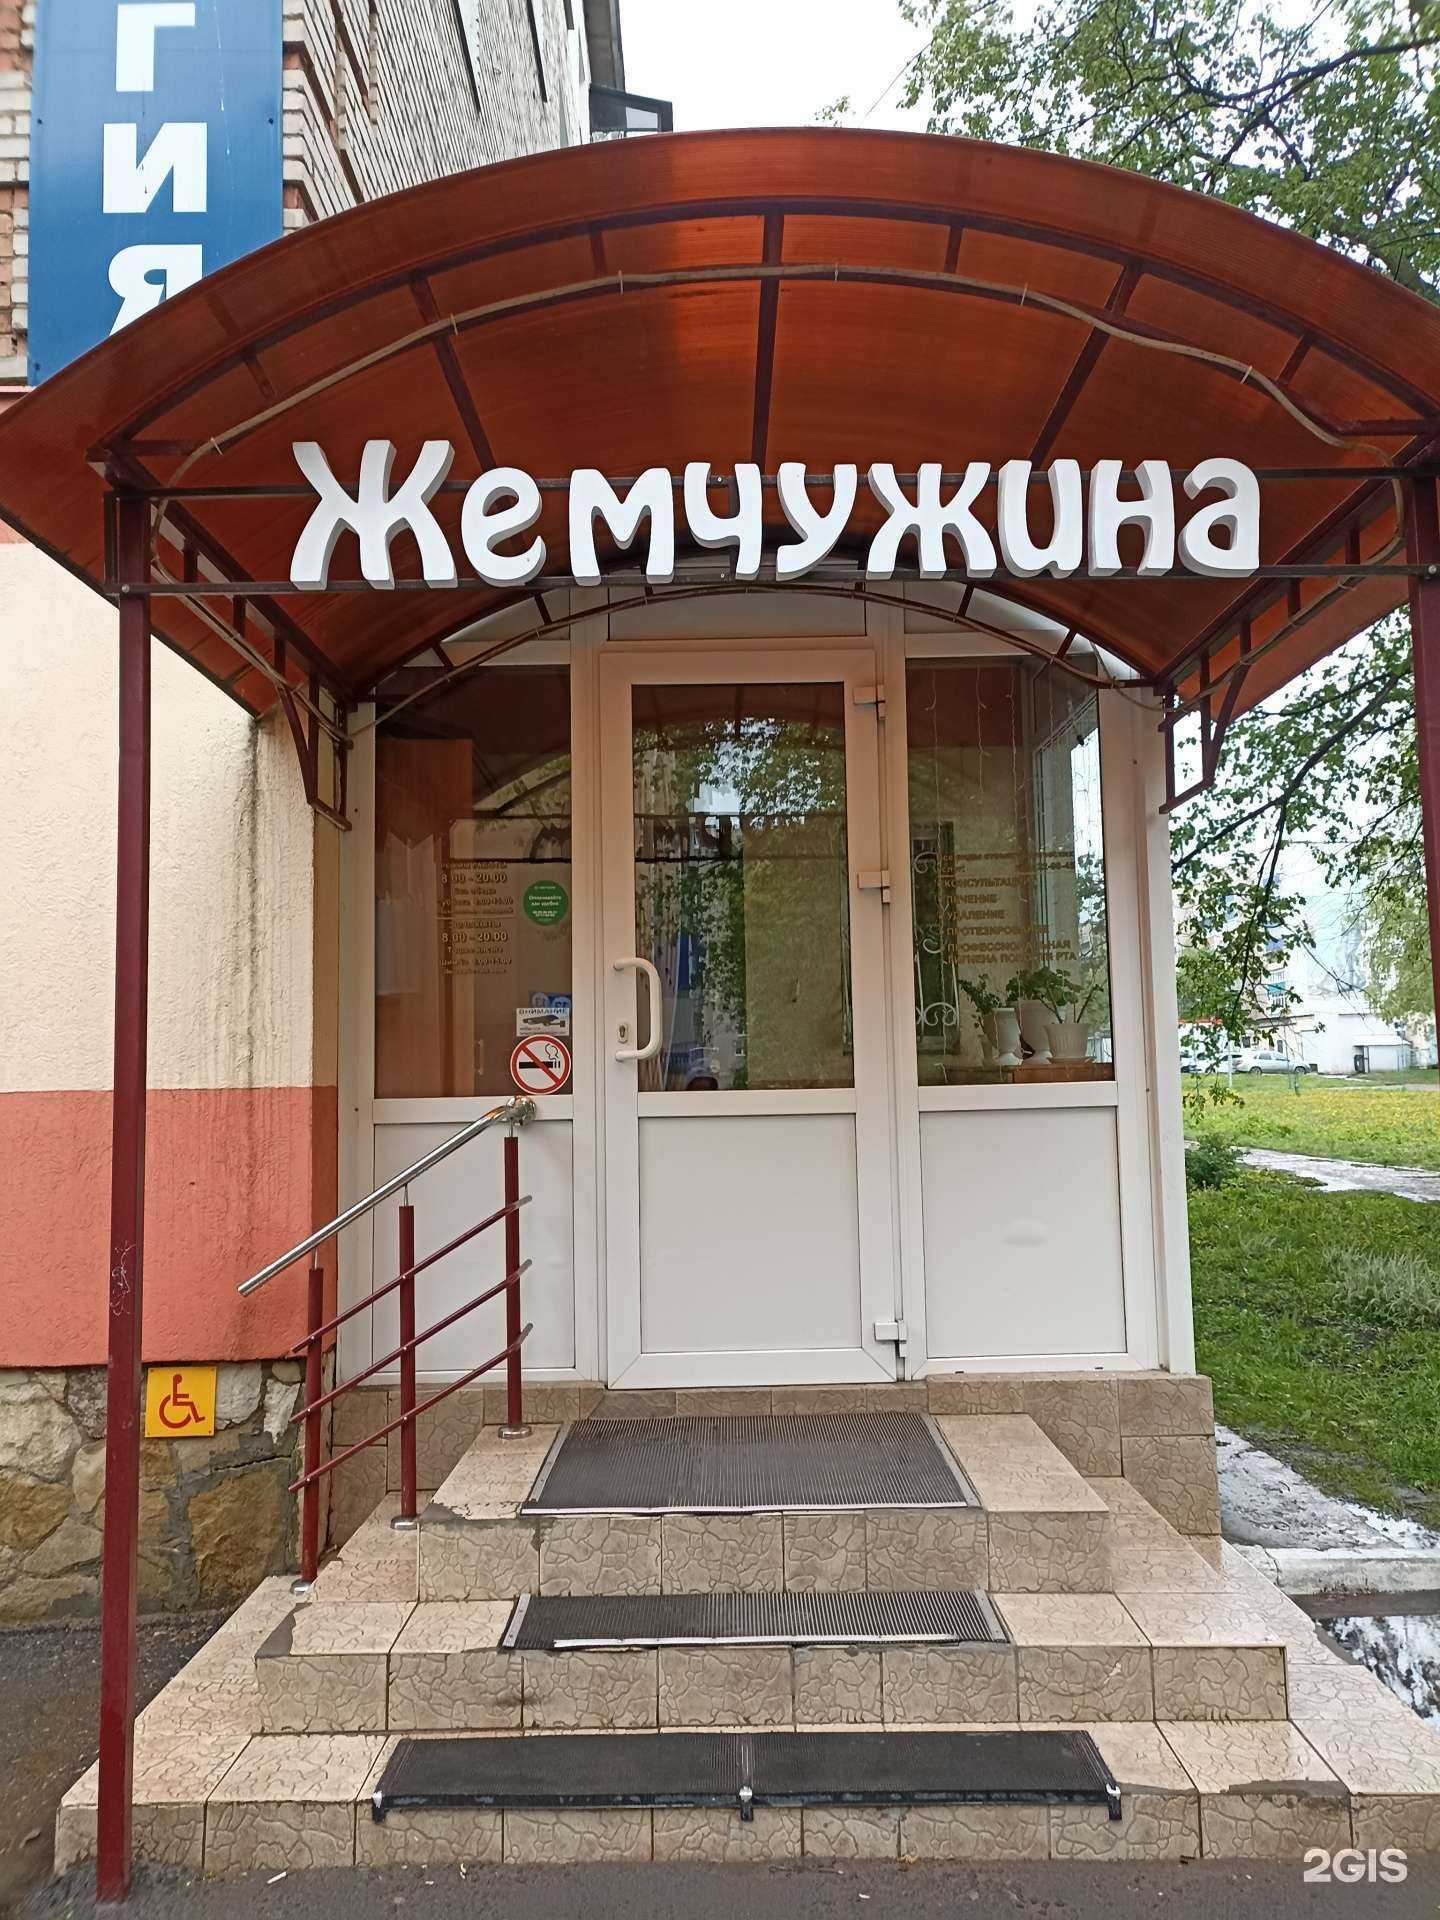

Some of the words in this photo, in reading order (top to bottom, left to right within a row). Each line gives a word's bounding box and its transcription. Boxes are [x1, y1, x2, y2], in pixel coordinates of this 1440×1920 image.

[290, 438, 1261, 590] Жемчужина
[476, 872, 508, 883] 20.00
[478, 931, 509, 942] 20.00
[1055, 951, 1077, 961] РТА
